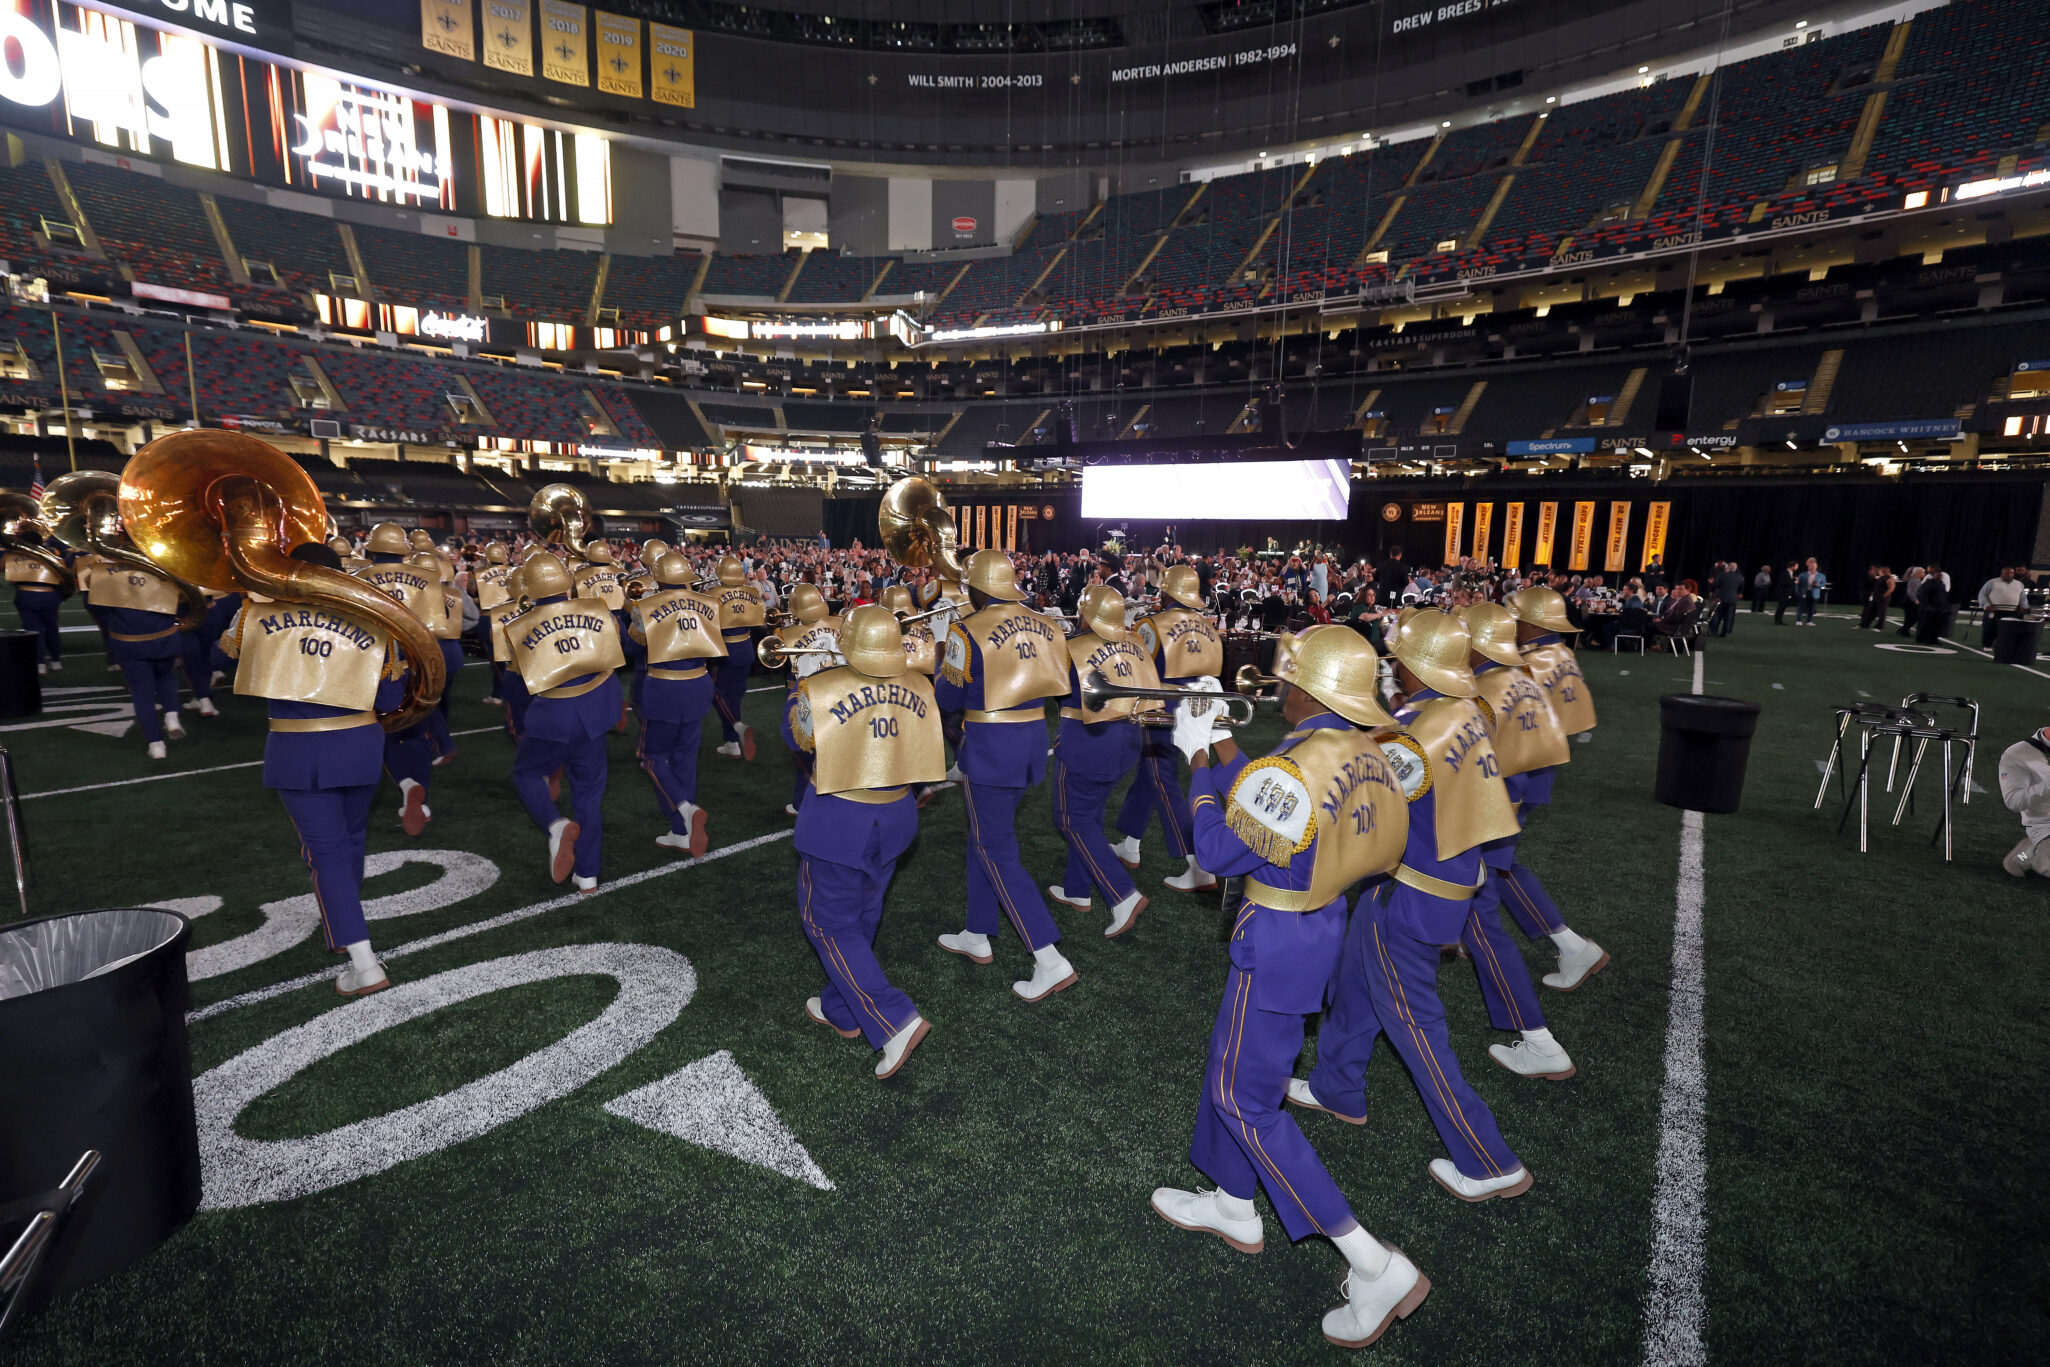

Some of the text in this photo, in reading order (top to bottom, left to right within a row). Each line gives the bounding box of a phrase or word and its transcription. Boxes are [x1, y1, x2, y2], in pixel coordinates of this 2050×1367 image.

[491, 3, 522, 22] 2017
[1393, 0, 1482, 33] DREW BREES
[549, 18, 579, 34] 2018
[604, 31, 634, 46] 2019
[656, 42, 687, 58] 2020
[1112, 43, 1297, 82] MORTEN ANDERSEN 1982-1994
[546, 67, 585, 84] SAINTS
[908, 74, 1042, 88] WILL SMITH 2004-2013
[601, 80, 639, 96] SAINTS
[655, 90, 691, 107] SAINTS
[1772, 208, 1830, 230] SAINTS
[1652, 231, 1703, 250] SAINTS
[1550, 250, 1594, 266] SAINTS
[1456, 265, 1496, 280] SAINTS
[1292, 291, 1325, 302] SAINTS
[1158, 308, 1187, 318] SAINTS
[1223, 300, 1254, 311] SAINTS
[1097, 315, 1125, 324] SAINTS
[0, 393, 49, 409] AINTS
[122, 405, 175, 419] SAINTS
[244, 418, 283, 430] TOYOTA
[1843, 422, 1959, 438] HANCOCK WHITNEY
[358, 427, 428, 443] CAESARS
[1601, 437, 1647, 449] SAINTS
[1687, 434, 1737, 447] entergy
[1529, 442, 1569, 451] Spectrum
[1580, 505, 1588, 523] DAVID
[1651, 520, 1662, 550] GARDNER
[128, 575, 146, 587] 100
[365, 572, 428, 590] ARCHING
[583, 572, 617, 589] MARCHI
[388, 589, 404, 601] 00
[720, 590, 759, 605] ARCHING
[650, 598, 715, 623] MARCHING
[731, 604, 745, 614] 100
[259, 610, 376, 651] MARCHING
[522, 614, 604, 651] MARCHING
[676, 618, 698, 631] 100
[987, 615, 1055, 650] MARCHING
[1166, 619, 1216, 643] MARCHING
[299, 637, 333, 658] 100
[554, 636, 580, 654] 100
[1015, 641, 1038, 659] 100
[1185, 640, 1202, 654] 100
[1086, 640, 1145, 673] MARCHING
[1114, 661, 1133, 678] 100
[829, 683, 929, 725] MARCHING
[869, 717, 899, 739] 100
[1476, 753, 1500, 779] 10
